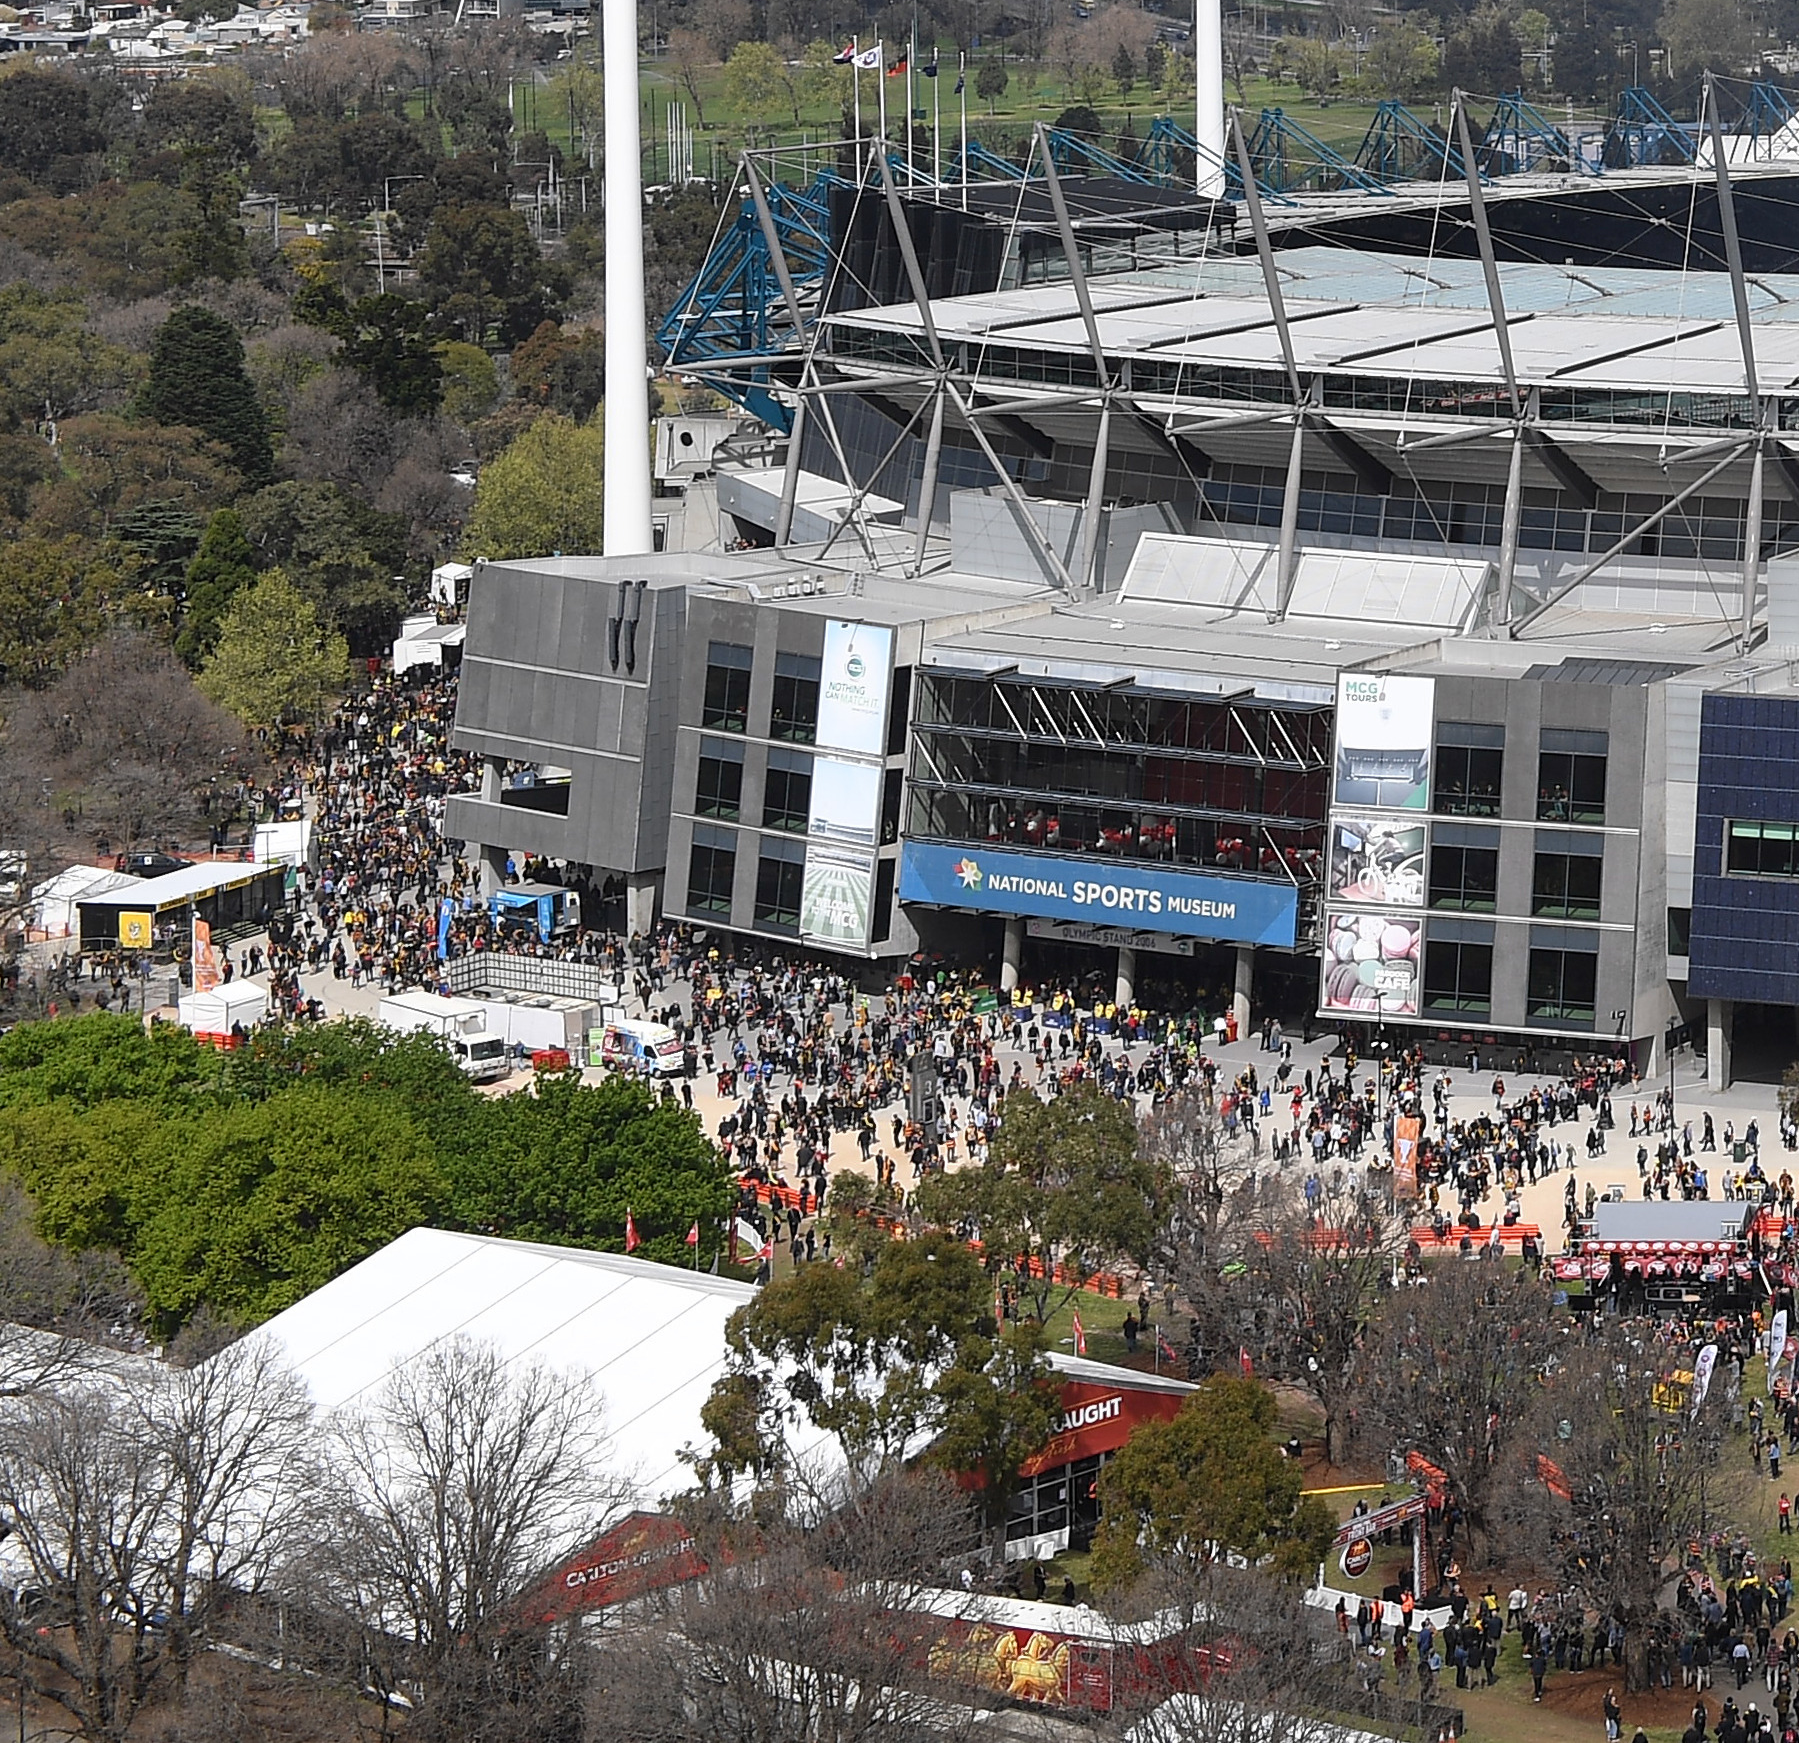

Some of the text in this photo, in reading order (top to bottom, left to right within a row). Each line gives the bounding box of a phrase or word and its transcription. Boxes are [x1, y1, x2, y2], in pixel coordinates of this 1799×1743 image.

[829, 682, 866, 696] NOTHING
[1346, 681, 1378, 694] MCG
[825, 691, 839, 700] CAN
[840, 693, 870, 707] MATCH
[1346, 693, 1378, 703] TOURS
[988, 874, 1236, 919] NATIONAL SPORTS MUSEUM
[830, 910, 860, 929] MCG
[1062, 927, 1156, 948] OLYMPIC STAND 2006
[924, 1080, 932, 1095] 3
[1053, 1396, 1123, 1433] AUGHT
[566, 1537, 697, 1589] CARLTON DRGHT
